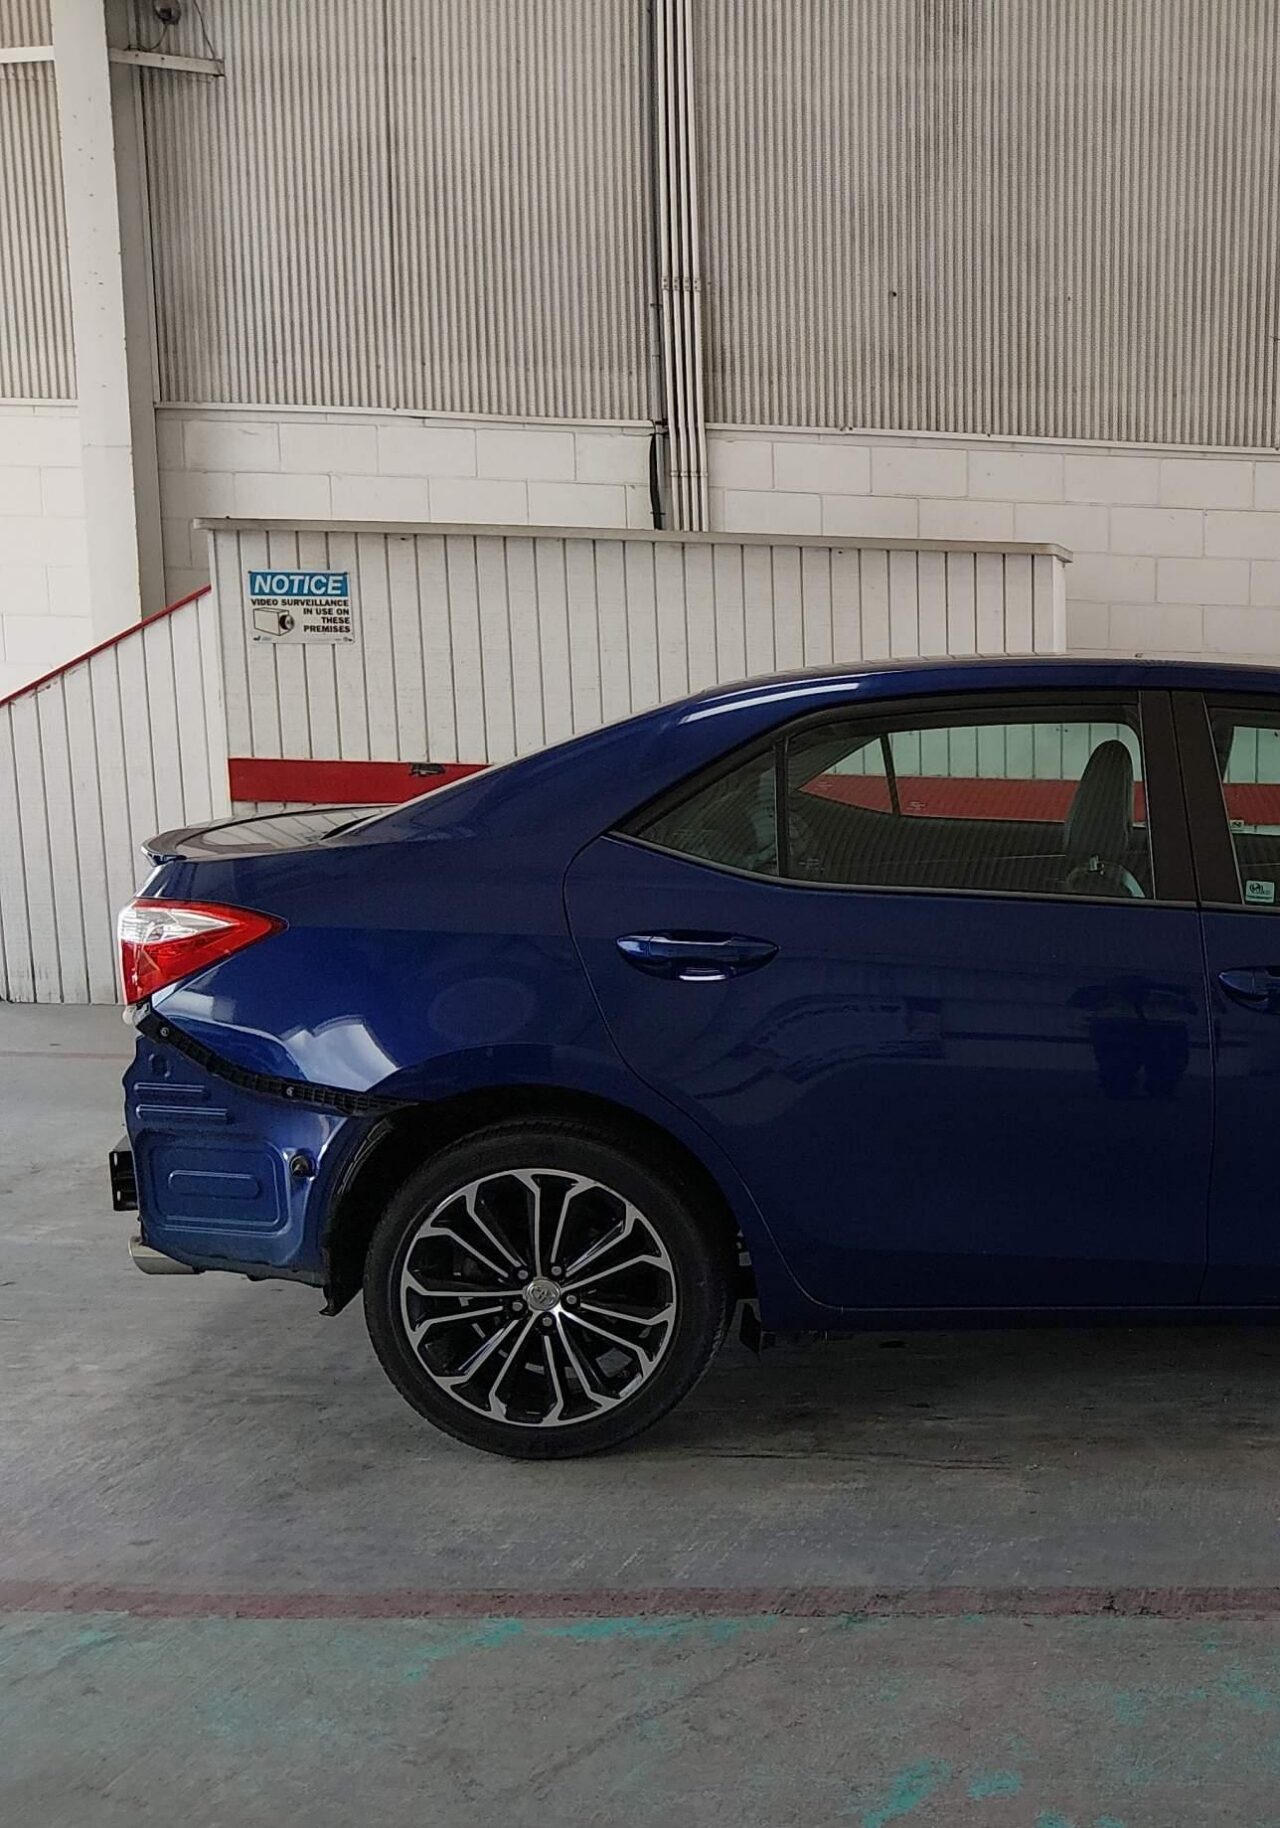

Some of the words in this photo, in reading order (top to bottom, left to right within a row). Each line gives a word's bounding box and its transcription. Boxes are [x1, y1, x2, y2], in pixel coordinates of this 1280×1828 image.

[254, 575, 343, 594] NOTICE
[281, 599, 349, 607] SURVEILLANCE
[303, 625, 351, 633] PREMISES
